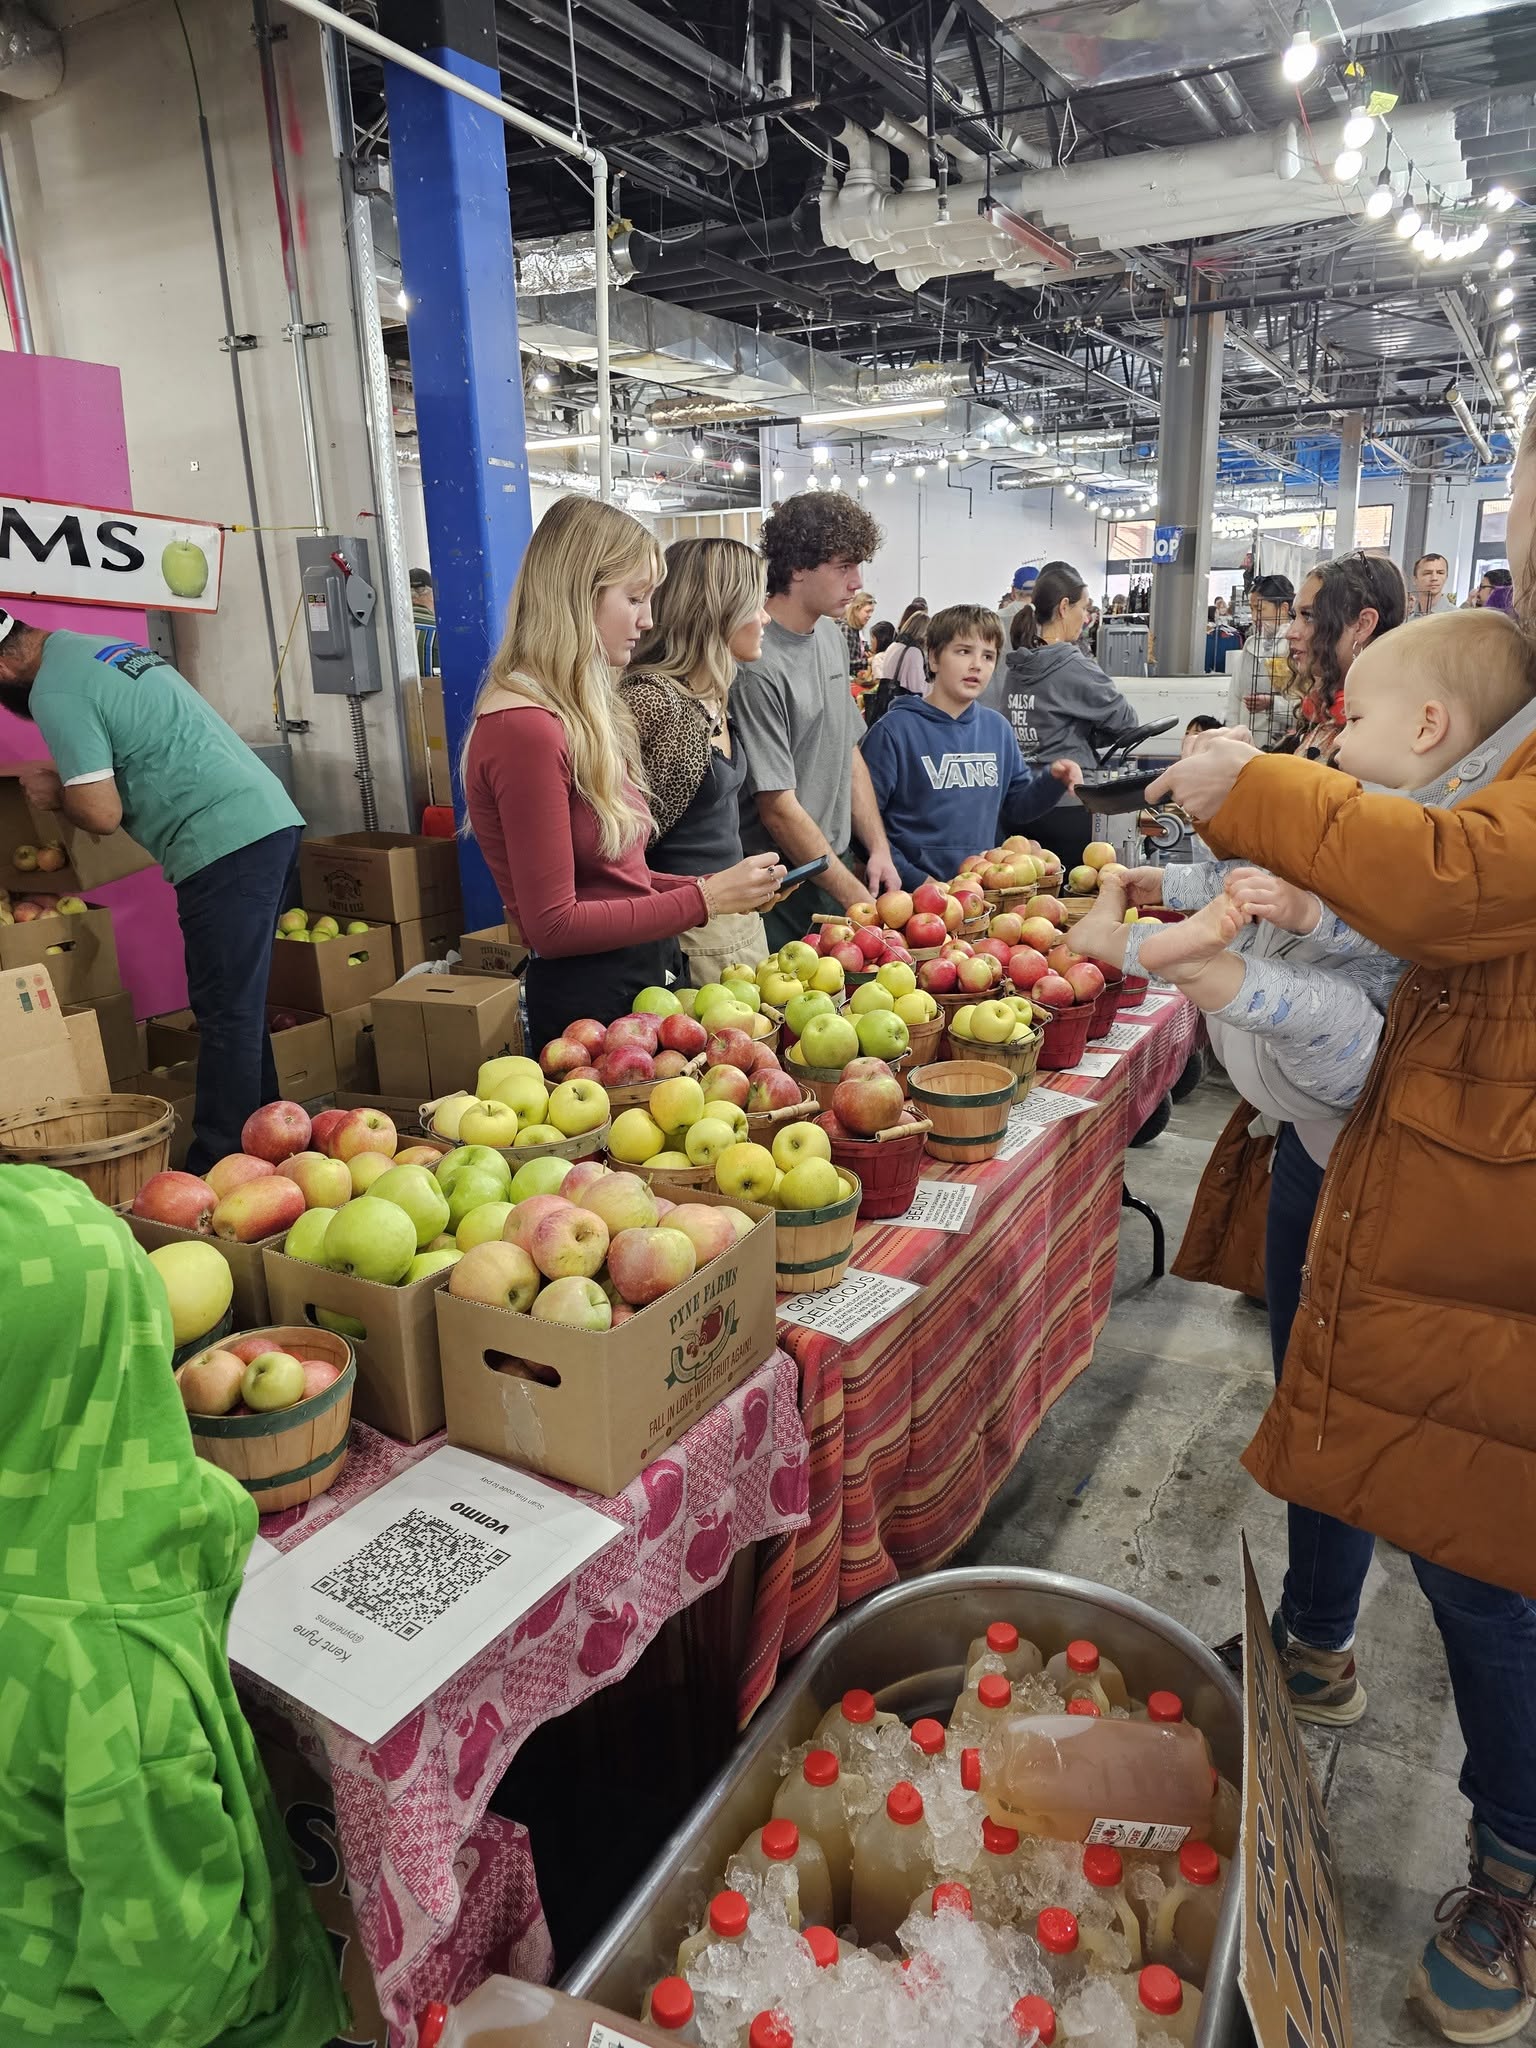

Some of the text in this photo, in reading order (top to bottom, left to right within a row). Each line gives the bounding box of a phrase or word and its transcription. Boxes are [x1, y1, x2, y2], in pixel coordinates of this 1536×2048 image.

[0, 506, 145, 572] MS
[1007, 693, 1035, 710] SALSA
[1011, 710, 1028, 726] DEL
[921, 753, 998, 790] VANS
[905, 1189, 933, 1221] BEAUTY
[669, 1267, 738, 1335] PYNE FARMS
[798, 1275, 876, 1325] DELICIOUS
[649, 1414, 665, 1437] FALL
[667, 1404, 675, 1421] IN
[676, 1391, 694, 1416] LOVE
[694, 1375, 712, 1400] WITH
[712, 1358, 731, 1387] FRUIT
[730, 1336, 752, 1367] AGAIN!
[480, 1477, 493, 1485] pay
[499, 1485, 516, 1496] code
[515, 1493, 528, 1503] this
[528, 1498, 545, 1511] Scan
[449, 1502, 510, 1535] venmo
[293, 1625, 352, 1663] Kent Pyne
[315, 1613, 366, 1645] @pynefarms
[1255, 1612, 1278, 1992] FRESH
[1128, 1830, 1141, 1845] CIDER
